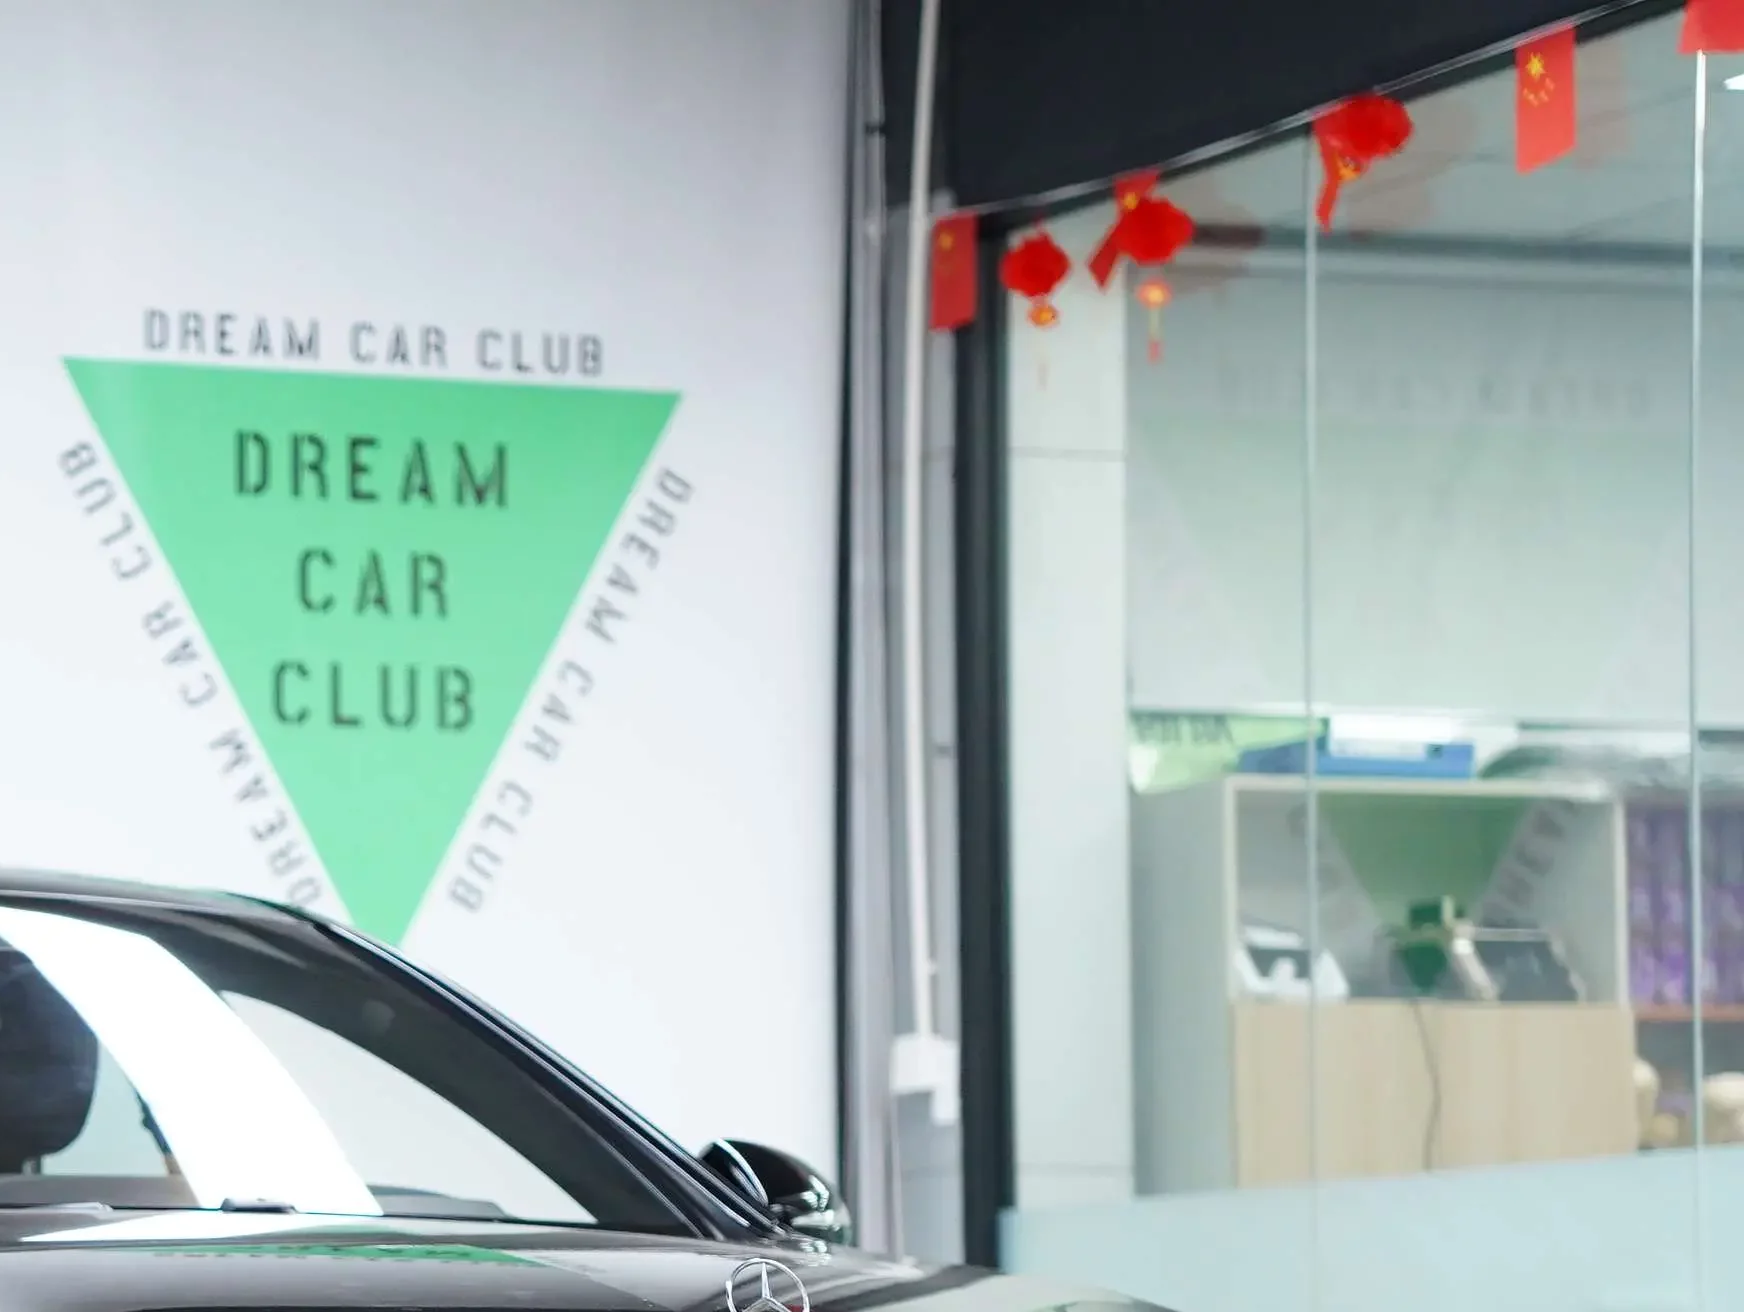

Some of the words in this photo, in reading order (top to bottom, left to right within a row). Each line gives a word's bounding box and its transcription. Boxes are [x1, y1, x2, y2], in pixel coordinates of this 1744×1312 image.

[144, 307, 320, 361] DREAM
[349, 320, 449, 370] CAR
[475, 328, 604, 378] CLUB
[57, 440, 153, 581] CLUB
[234, 428, 508, 508] DREAM
[297, 547, 449, 619] CAR
[584, 466, 695, 645] DREAM
[141, 598, 219, 708] CAR
[271, 659, 473, 732] CLUB
[523, 659, 596, 764] CAR
[209, 727, 323, 907] DREAM
[447, 778, 534, 914] CLUB
